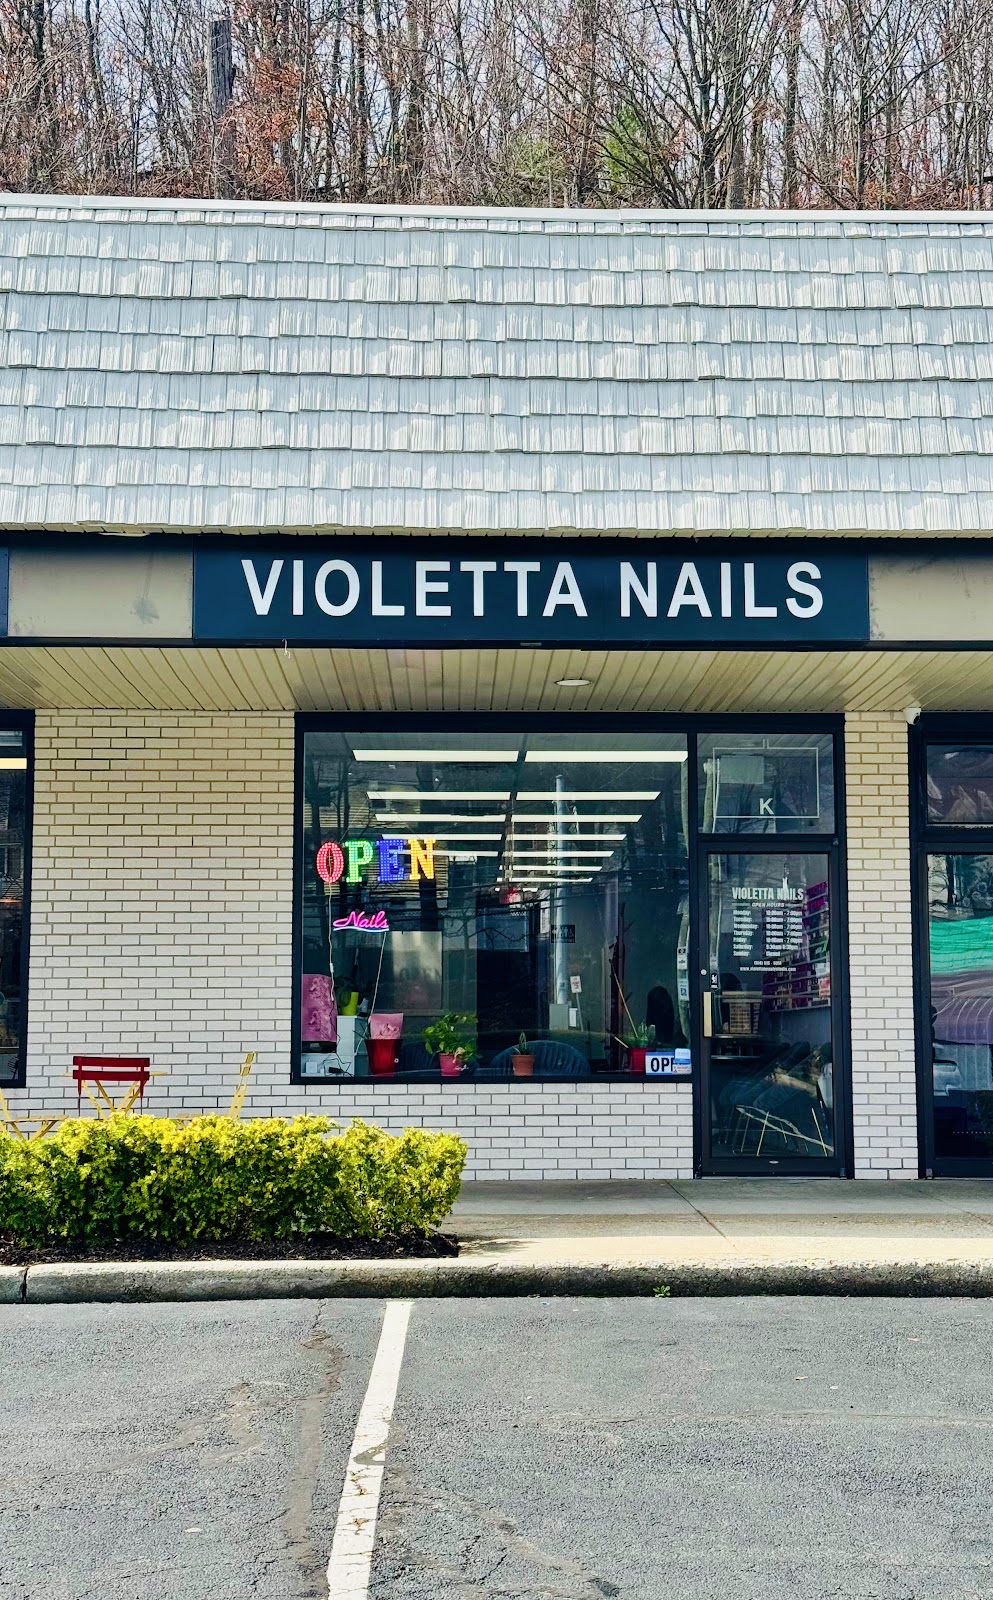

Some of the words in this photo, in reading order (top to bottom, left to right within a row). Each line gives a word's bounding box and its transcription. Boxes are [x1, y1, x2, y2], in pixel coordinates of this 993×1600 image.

[241, 559, 588, 617] VIOLETTA
[620, 562, 824, 619] NAILS
[759, 798, 774, 815] K
[316, 838, 436, 883] OPEN
[732, 887, 775, 900] VIOLETTA
[777, 888, 804, 900] NAILS
[333, 910, 390, 928] Nails
